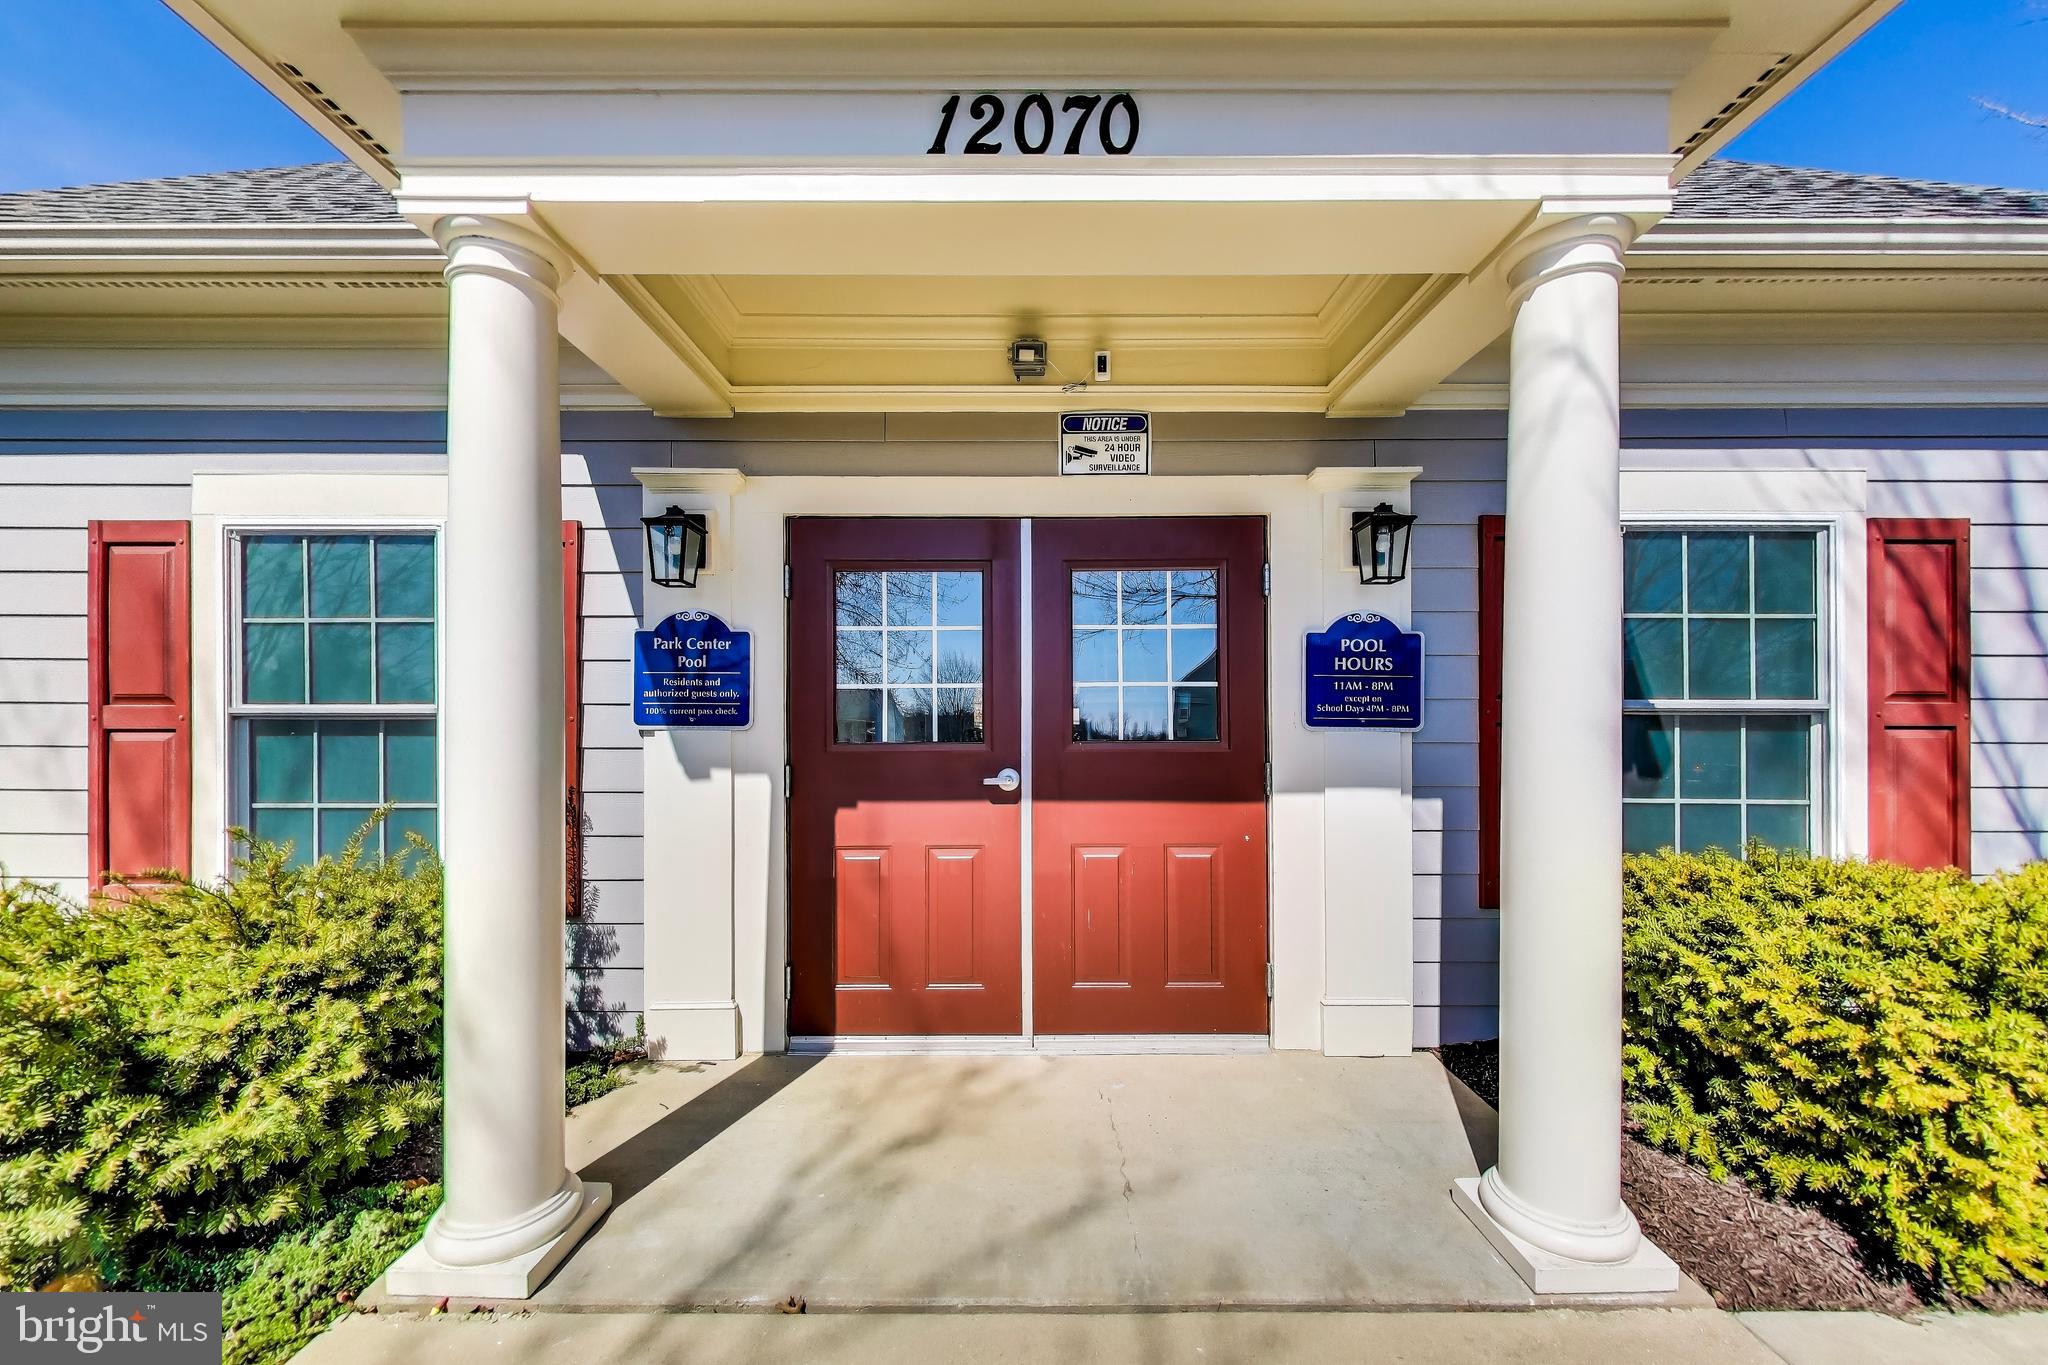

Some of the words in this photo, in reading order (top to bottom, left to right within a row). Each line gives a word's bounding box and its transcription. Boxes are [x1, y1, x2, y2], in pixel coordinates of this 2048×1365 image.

[926, 92, 1140, 155] 12070
[1082, 417, 1129, 431] NOTICE
[1104, 444, 1115, 452] 24
[1117, 444, 1141, 452] HOUR
[1110, 454, 1136, 462] VIDEO
[653, 637, 682, 649] Park
[686, 638, 732, 650] Center
[1340, 639, 1386, 652] POOL
[678, 655, 707, 668] Pool
[1334, 657, 1393, 671] HOURS
[663, 678, 702, 686] Residents
[704, 678, 721, 686] and
[1334, 682, 1362, 690] 11AM
[1372, 682, 1394, 690] 8PM
[644, 689, 689, 698] authorized
[691, 690, 718, 699] guests
[719, 689, 740, 700] only.
[714, 707, 738, 715] check.
[1316, 704, 1342, 712] School
[1346, 705, 1364, 714] Days
[1392, 705, 1410, 713] 8PM
